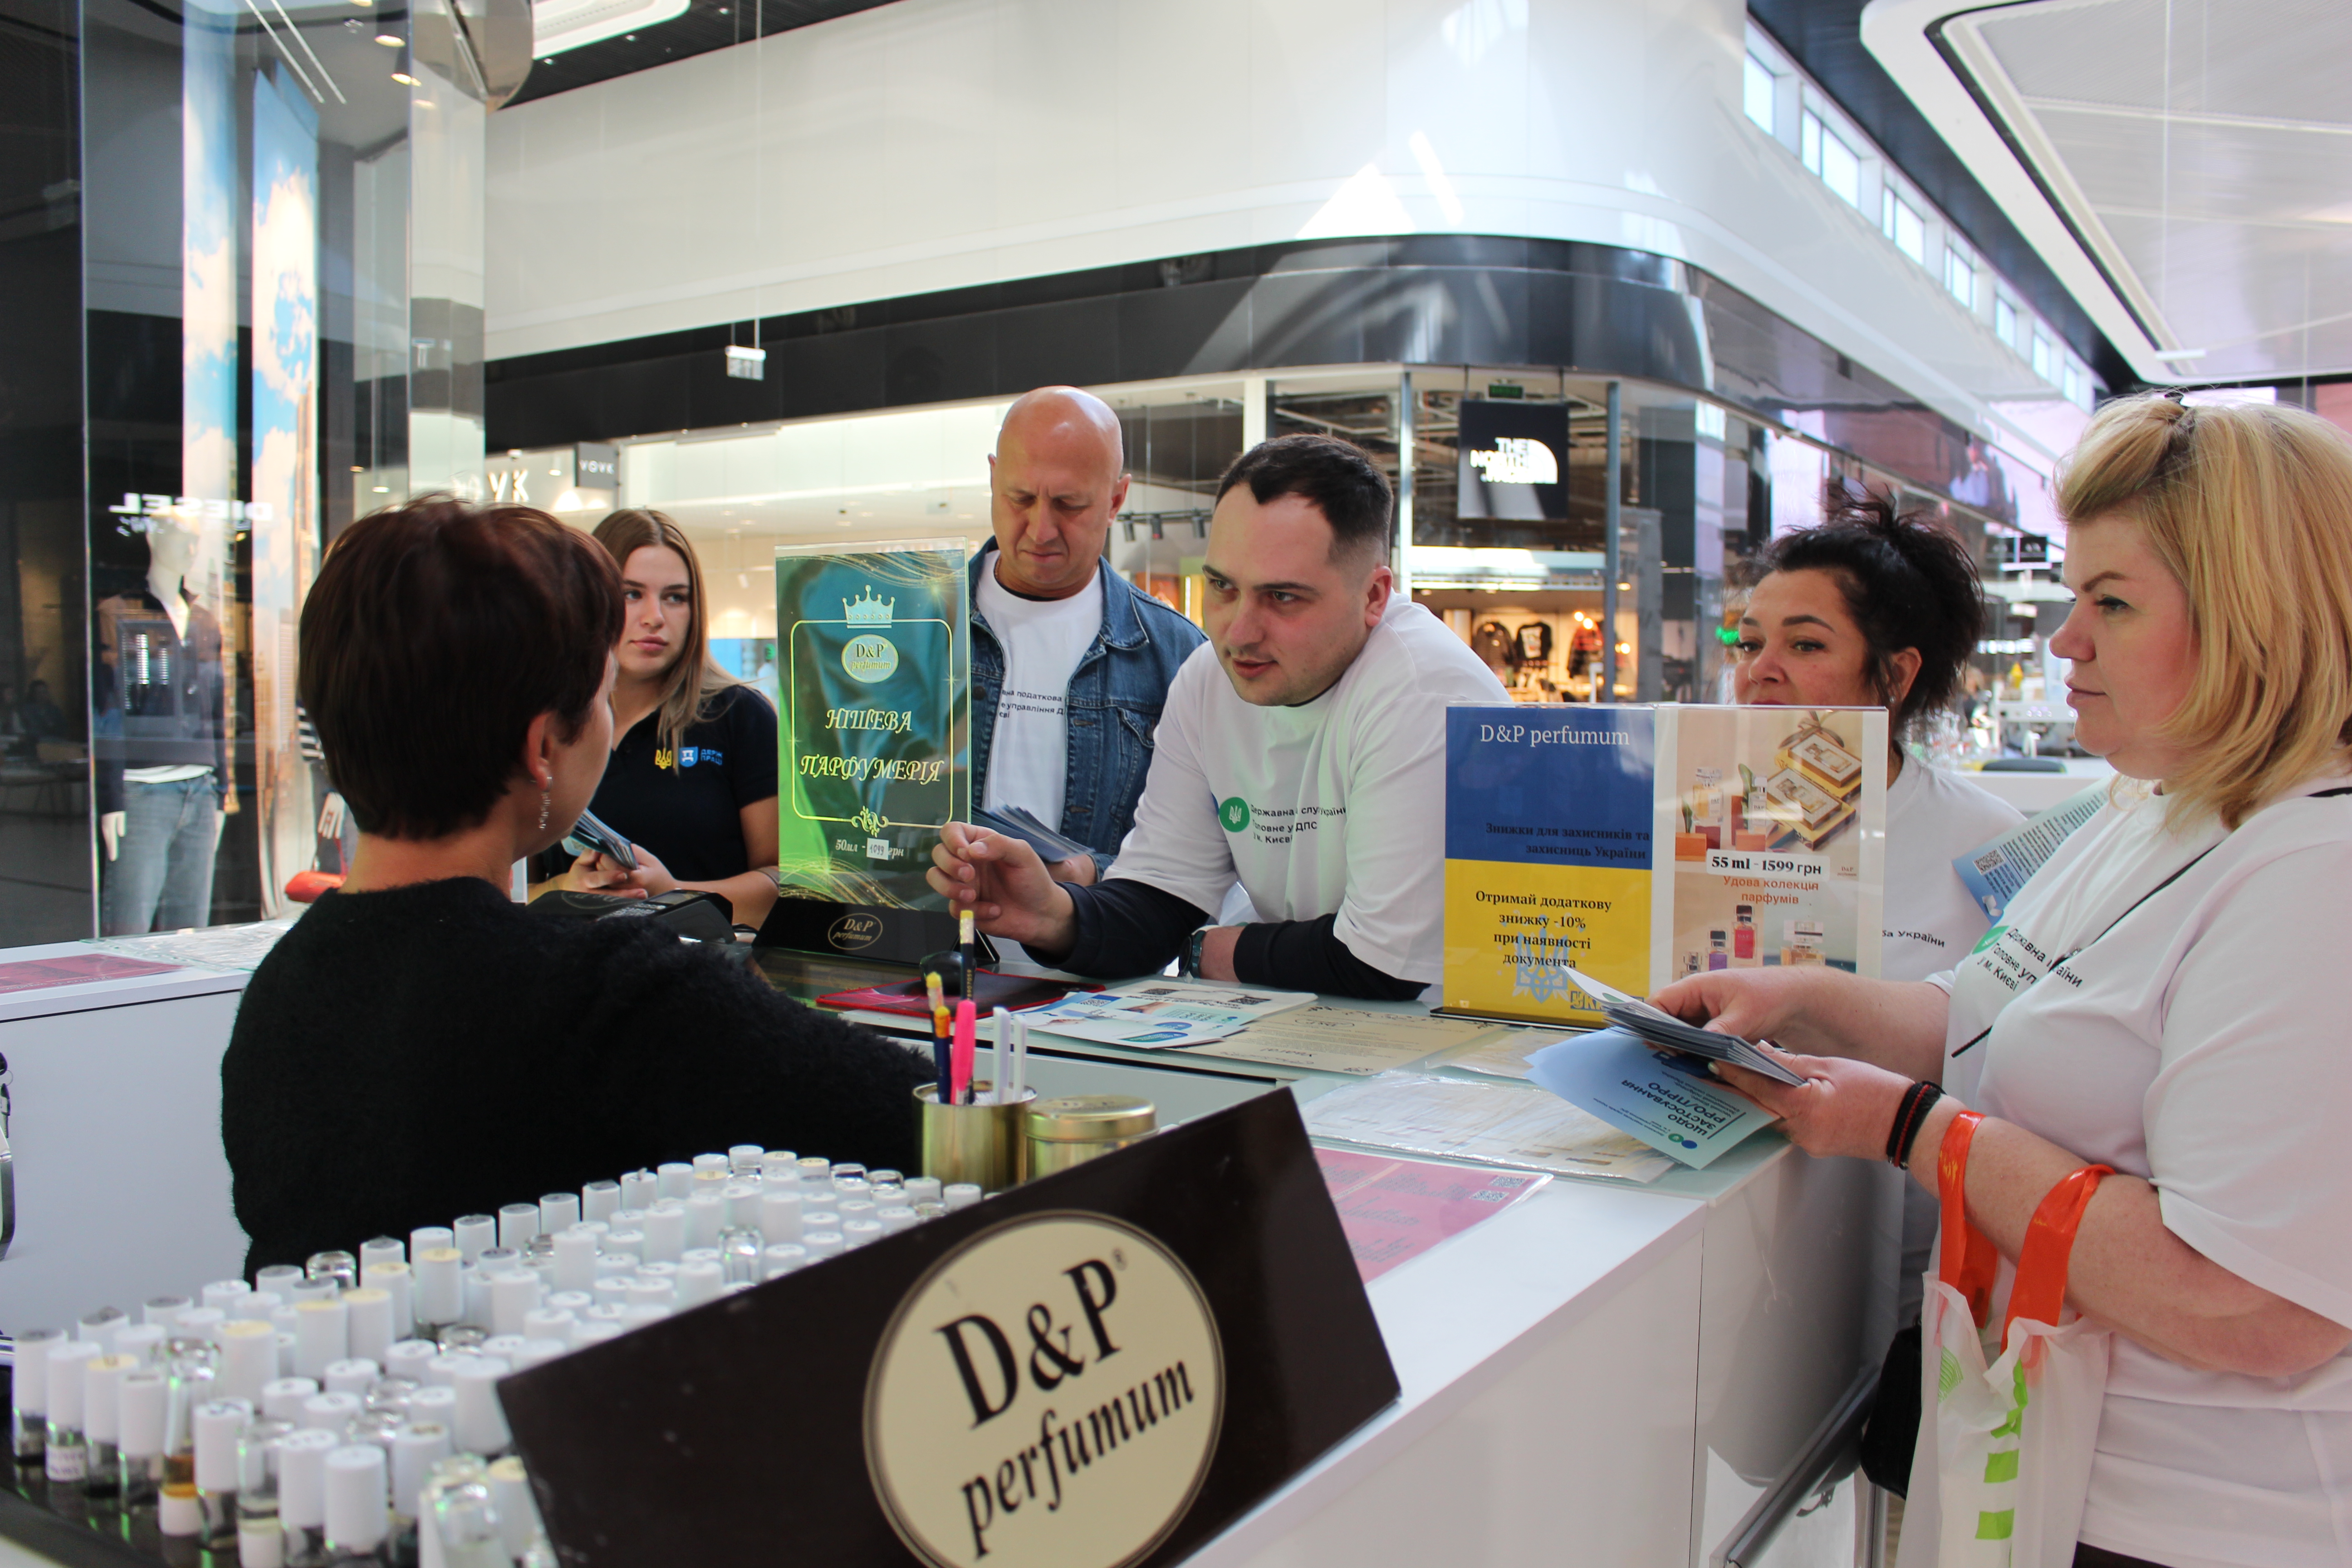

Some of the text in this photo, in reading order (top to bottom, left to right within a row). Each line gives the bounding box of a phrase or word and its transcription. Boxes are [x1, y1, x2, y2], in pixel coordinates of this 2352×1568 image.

[579, 460, 615, 475] VOVK
[856, 643, 884, 658] D&P
[1017, 691, 1062, 702] податкова
[1006, 703, 1054, 714] управління
[1056, 707, 1063, 715] Д
[825, 707, 912, 734] НІШЕВА
[1480, 724, 1630, 748] D&P perfumum
[799, 754, 945, 785] ПАРФУМЕРІЯ
[1295, 821, 1318, 832] ДПС
[1486, 822, 1650, 841] Знижки для захисників та
[835, 839, 858, 852] 50мл
[1265, 834, 1293, 844] Києві
[1526, 844, 1646, 860] захисниць України
[1711, 856, 1728, 868] 55
[1732, 858, 1750, 870] ml
[1762, 859, 1793, 872] 1599
[1797, 863, 1821, 876] грн
[1724, 876, 1819, 891] Удова колекція
[1475, 890, 1612, 912] Отримай додаткову
[1741, 892, 1799, 905] парфумів
[843, 918, 874, 932] D&P
[1499, 914, 1586, 929] знижку -10%
[1494, 933, 1591, 950] при наявності
[1898, 931, 1945, 948] України
[1503, 953, 1576, 968] документа
[1621, 1079, 1717, 1129] ЗАСТОСУВАННЯ
[1648, 1082, 1725, 1124] РРО/ПРРО
[1667, 1113, 1710, 1136] ЩОДО
[933, 1259, 1122, 1430] D&P
[960, 1360, 1194, 1561] perfumum
